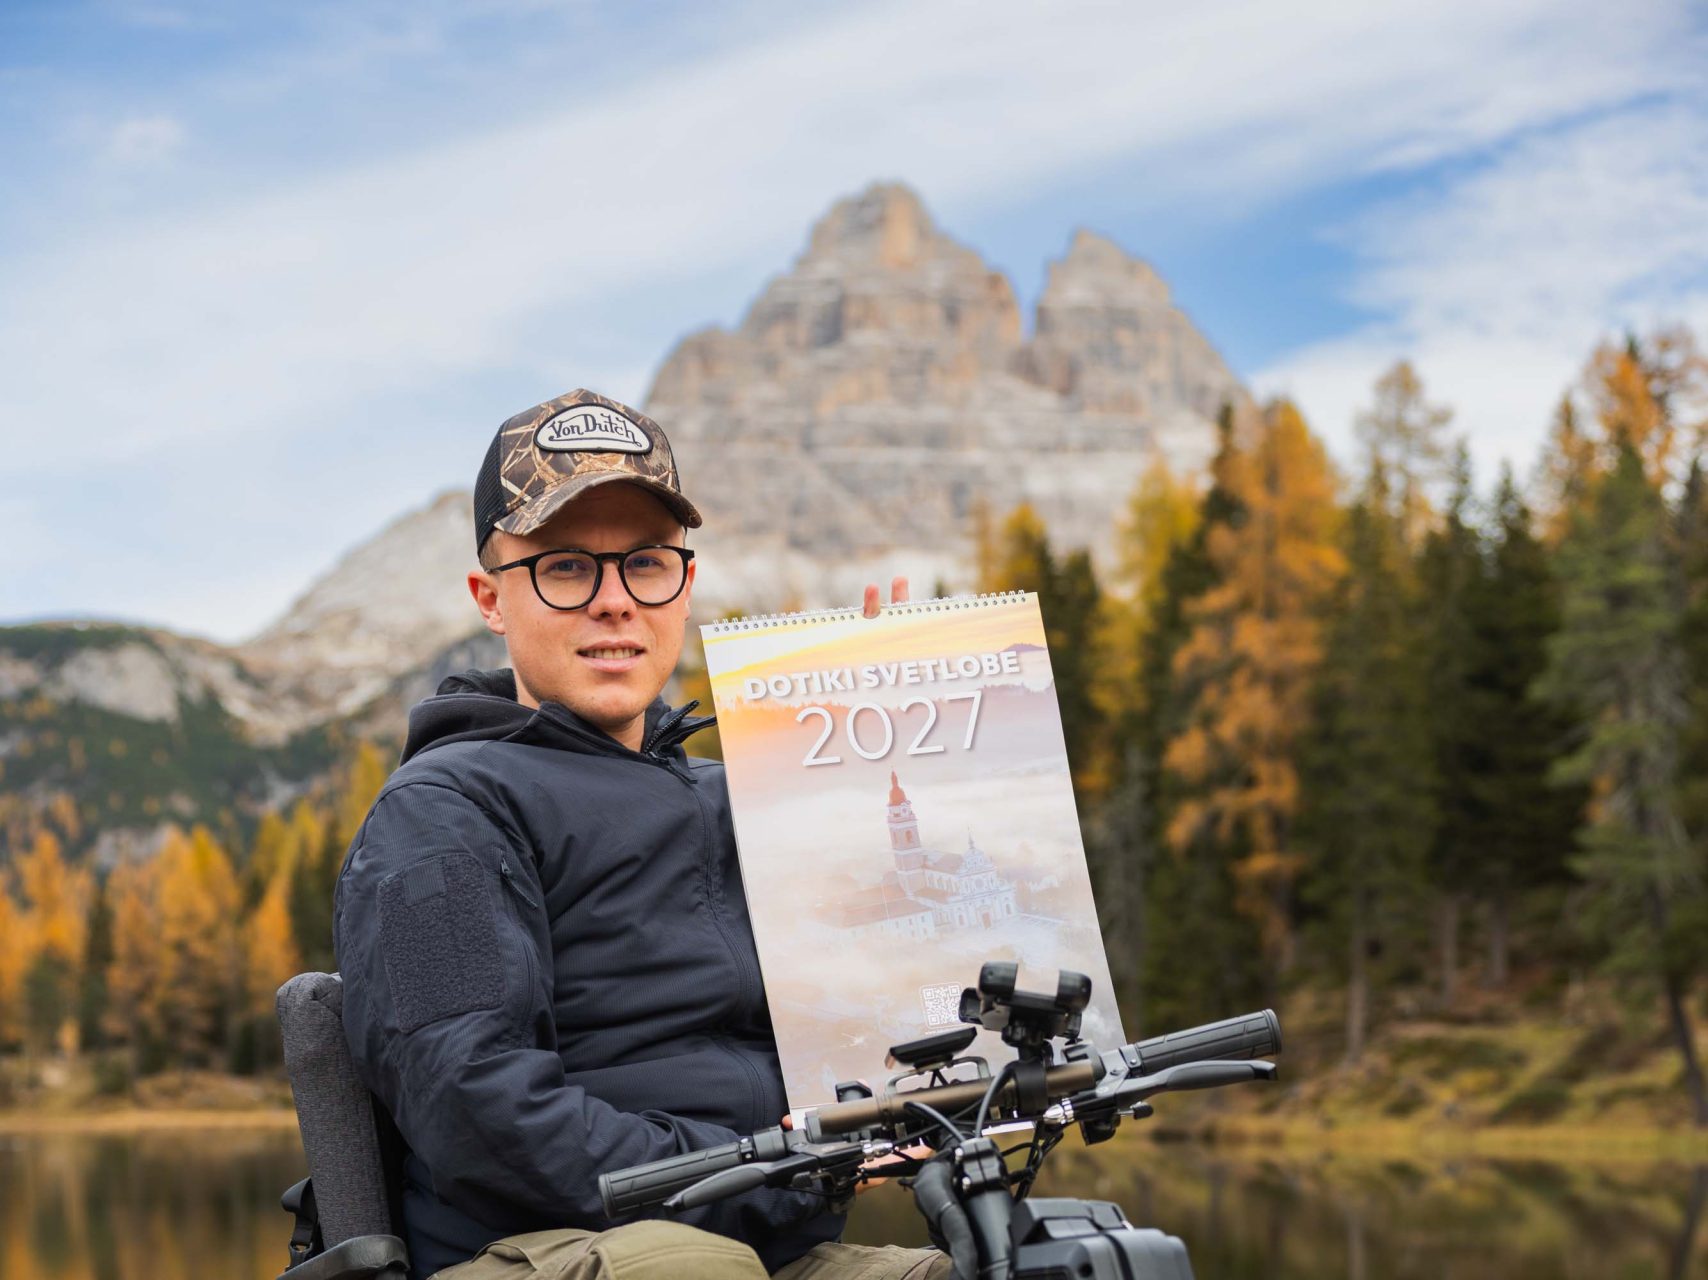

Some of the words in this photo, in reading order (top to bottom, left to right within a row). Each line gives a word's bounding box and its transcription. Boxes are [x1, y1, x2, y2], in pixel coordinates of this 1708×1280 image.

[548, 418, 584, 438] Von
[582, 413, 642, 447] Dutch
[744, 668, 855, 700] DOTIKI
[862, 650, 1021, 688] SVETLOBE
[796, 690, 982, 766] 2027
